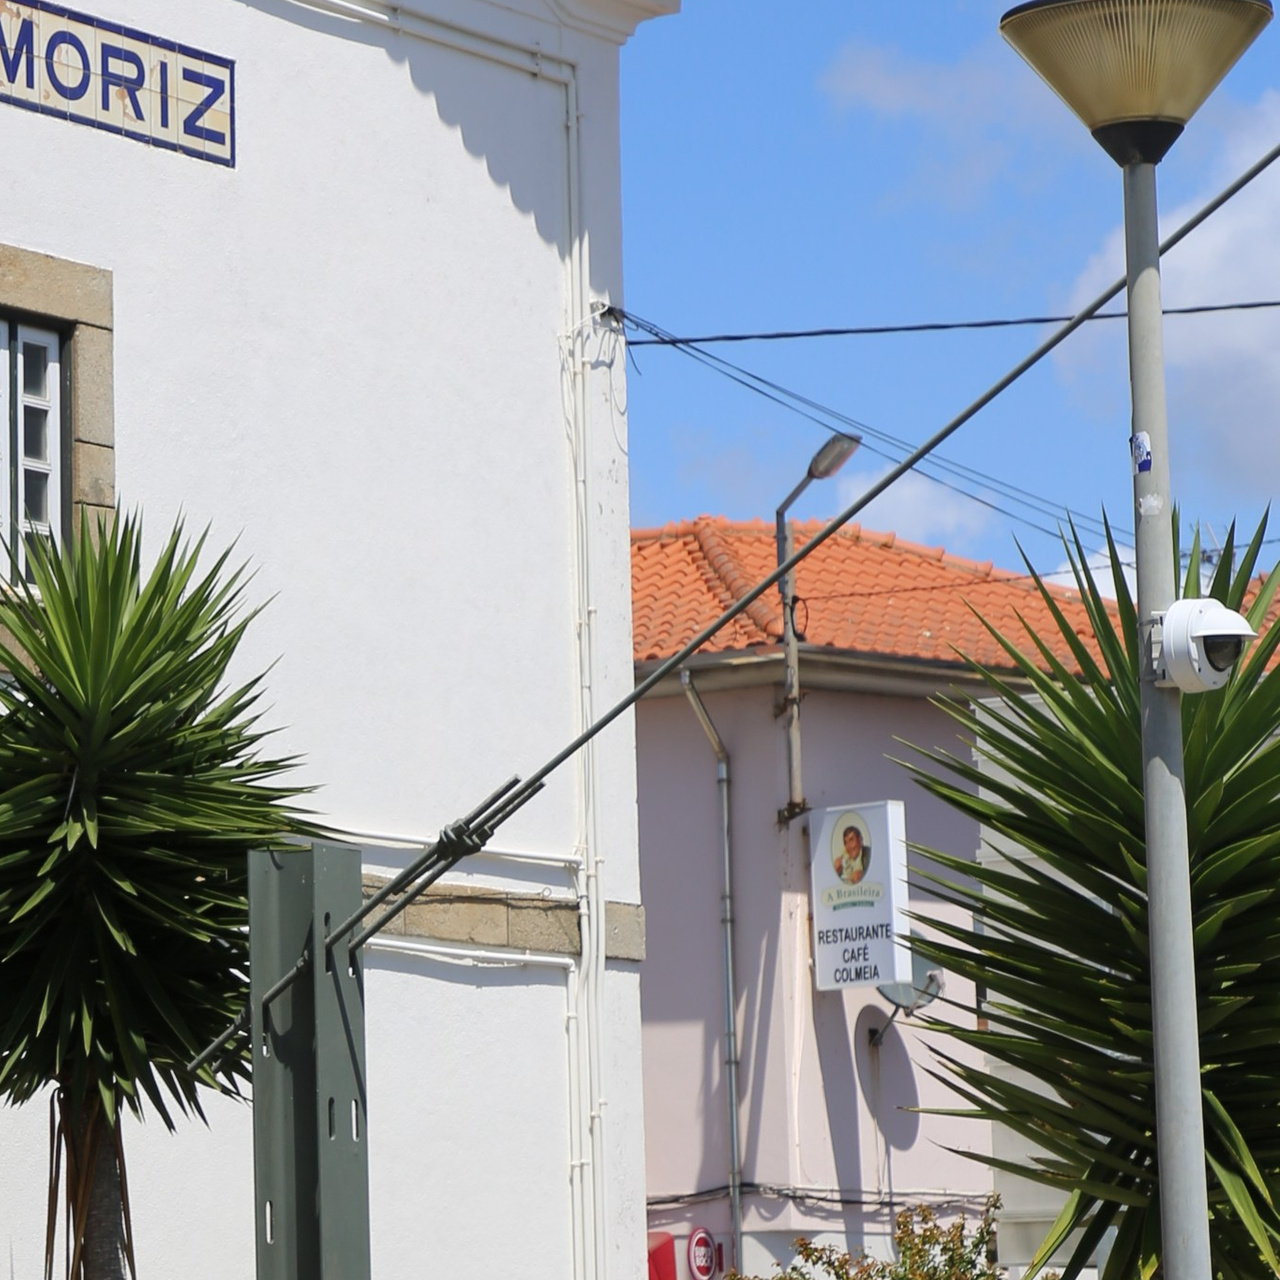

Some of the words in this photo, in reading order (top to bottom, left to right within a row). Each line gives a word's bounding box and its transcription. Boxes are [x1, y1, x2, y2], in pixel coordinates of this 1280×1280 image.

[836, 886, 881, 899] Brasileira
[818, 923, 891, 945] RESTAURANTE
[843, 944, 869, 963] CAFÉ
[834, 964, 880, 983] COLMEIA
